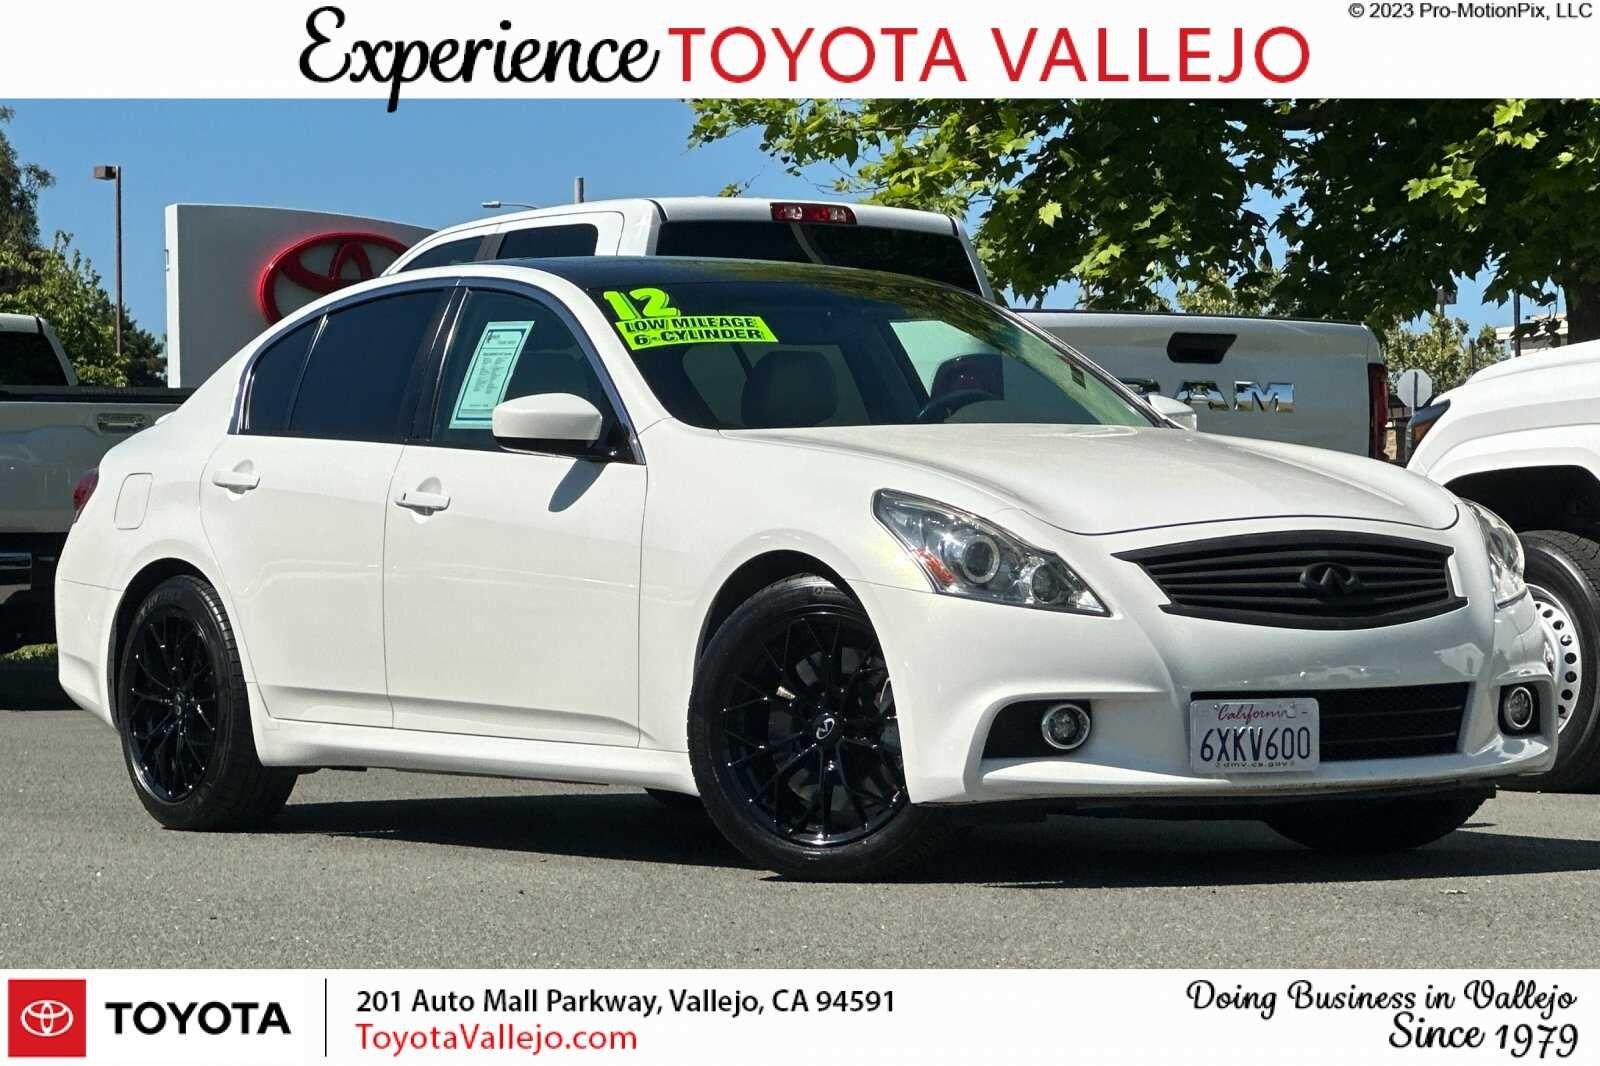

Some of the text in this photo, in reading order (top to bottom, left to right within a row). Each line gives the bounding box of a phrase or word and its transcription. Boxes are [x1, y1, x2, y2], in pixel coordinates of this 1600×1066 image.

[603, 287, 681, 321] 12
[624, 316, 757, 333] LOW MILEAGE
[633, 328, 763, 345] 6-CYLINDER
[1217, 704, 1296, 724] California
[1200, 726, 1311, 762] 6XKV600
